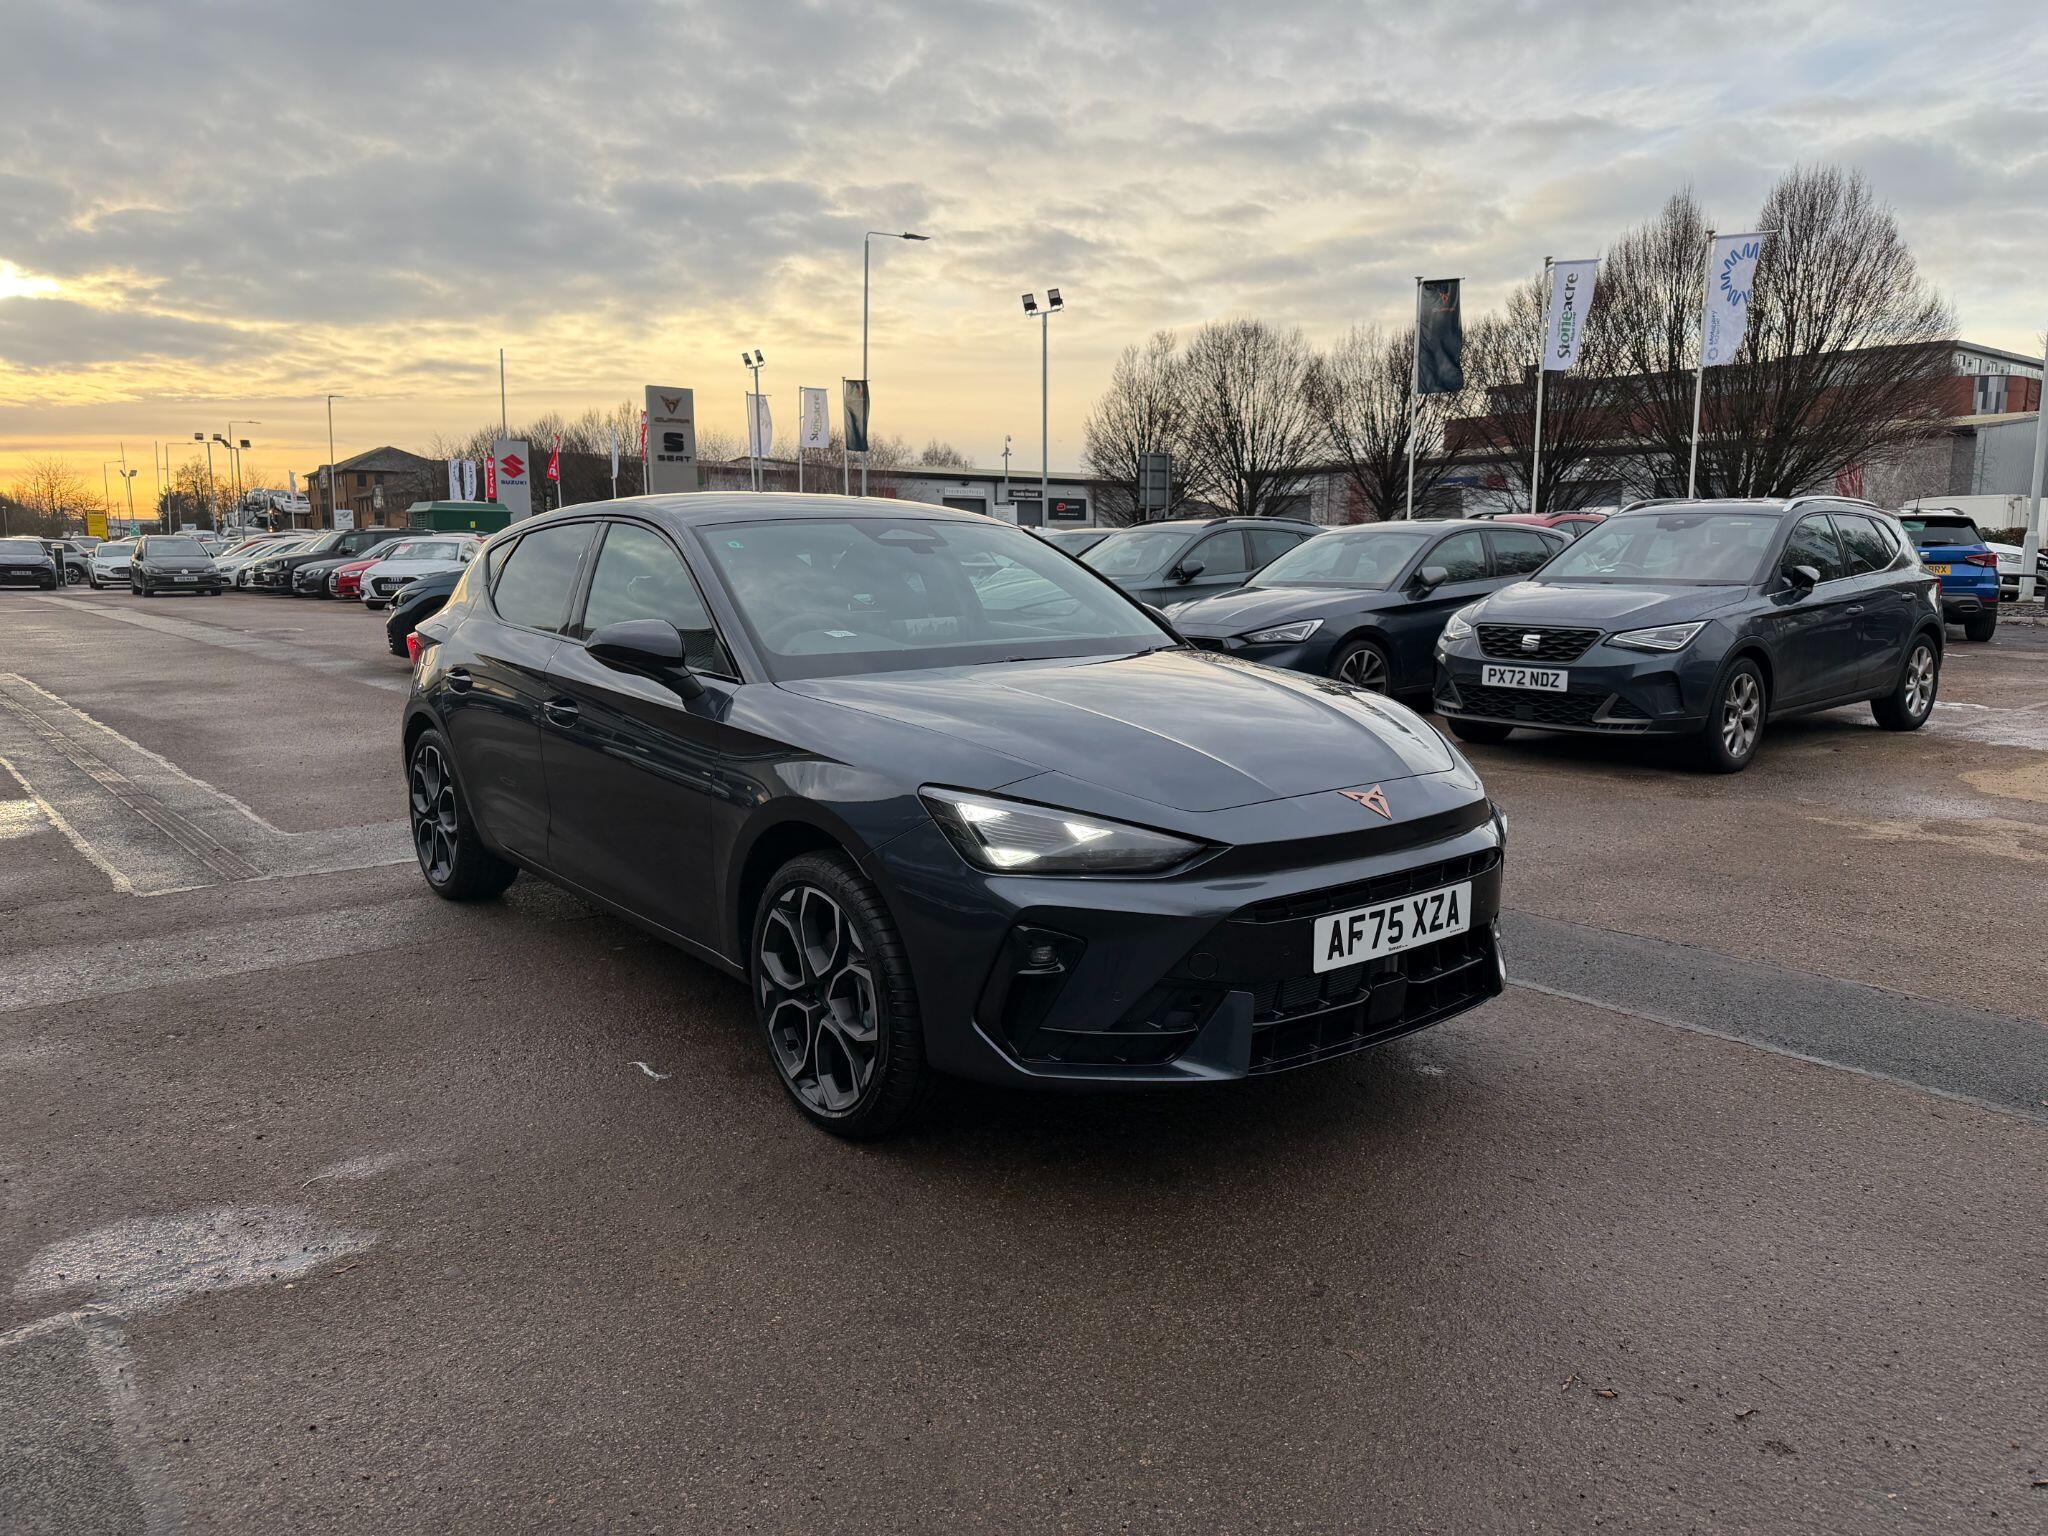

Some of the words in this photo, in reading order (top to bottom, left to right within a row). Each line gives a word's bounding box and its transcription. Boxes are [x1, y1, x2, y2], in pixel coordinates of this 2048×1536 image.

[1557, 272, 1578, 359] Stoneacre
[657, 454, 692, 462] SEAT
[1487, 668, 1526, 686] PX72
[1529, 671, 1560, 688] NDZ
[1327, 904, 1404, 961] AF75
[1412, 890, 1459, 938] XZA
